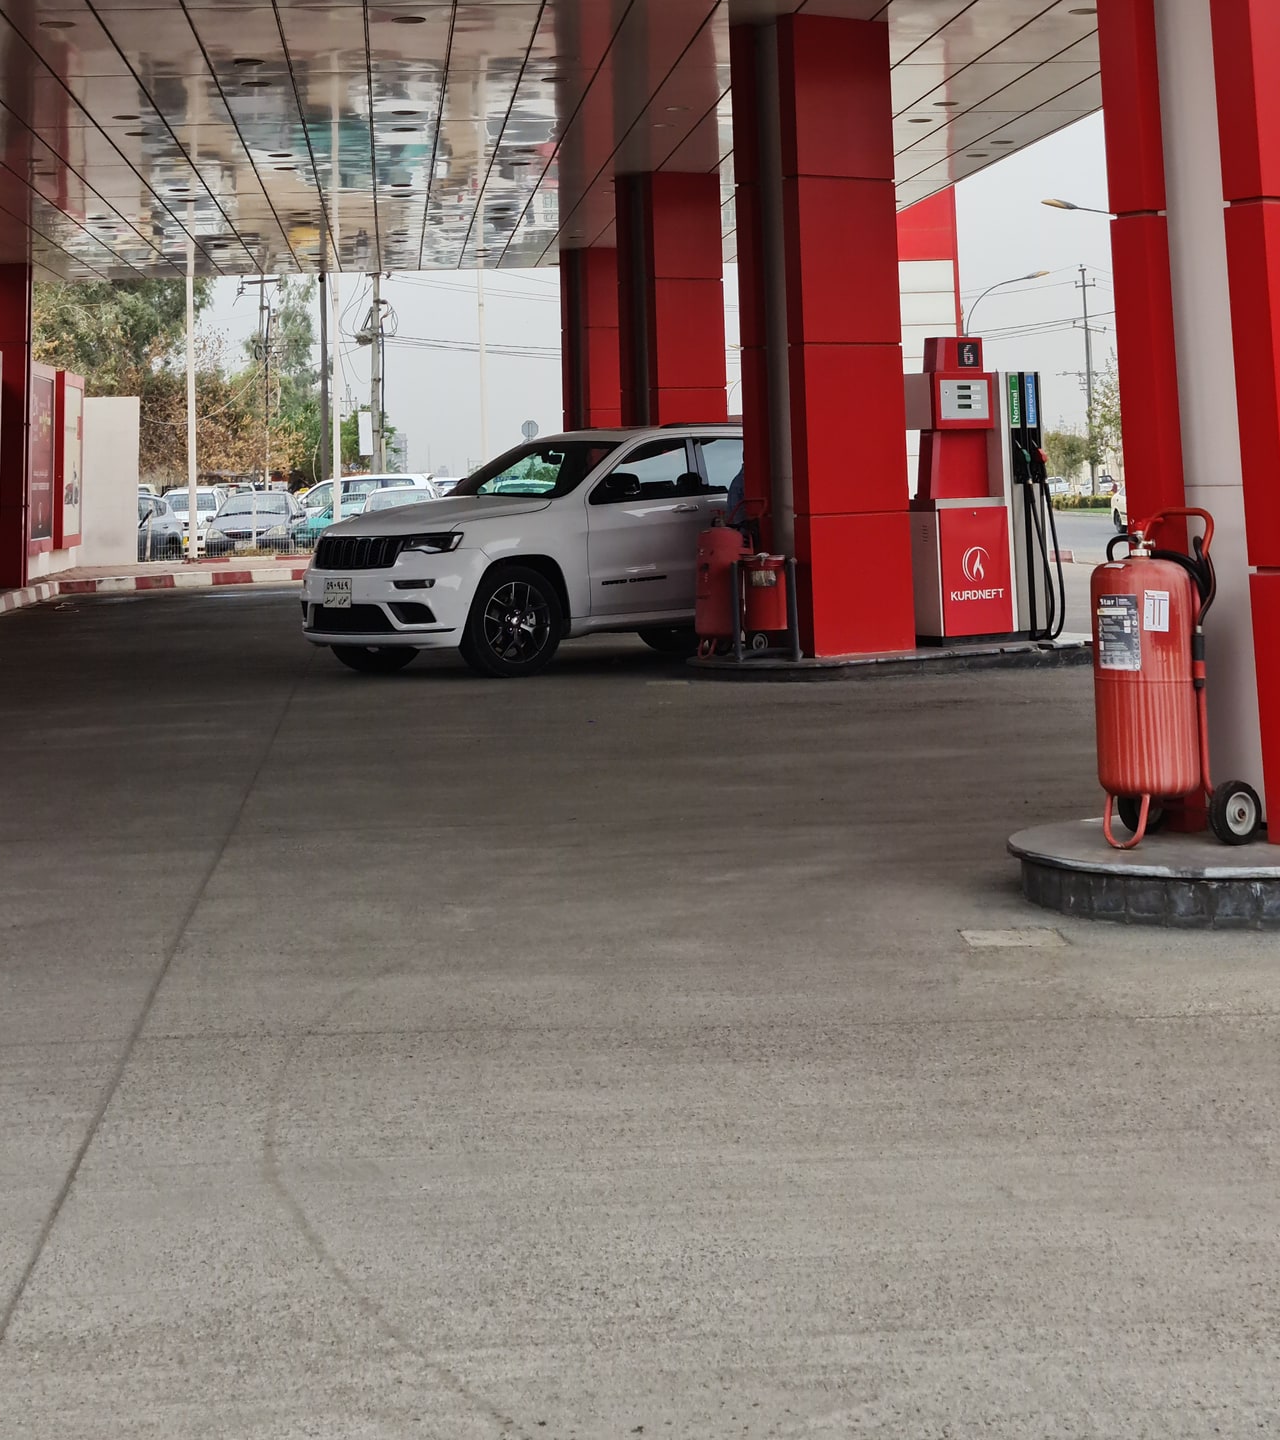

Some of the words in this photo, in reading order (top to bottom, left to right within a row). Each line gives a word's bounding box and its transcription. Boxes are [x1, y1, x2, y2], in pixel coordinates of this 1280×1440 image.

[963, 344, 974, 365] 6
[1012, 389, 1020, 423] Normal
[1026, 383, 1036, 423] Improved
[950, 588, 1004, 601] KURDNEFT
